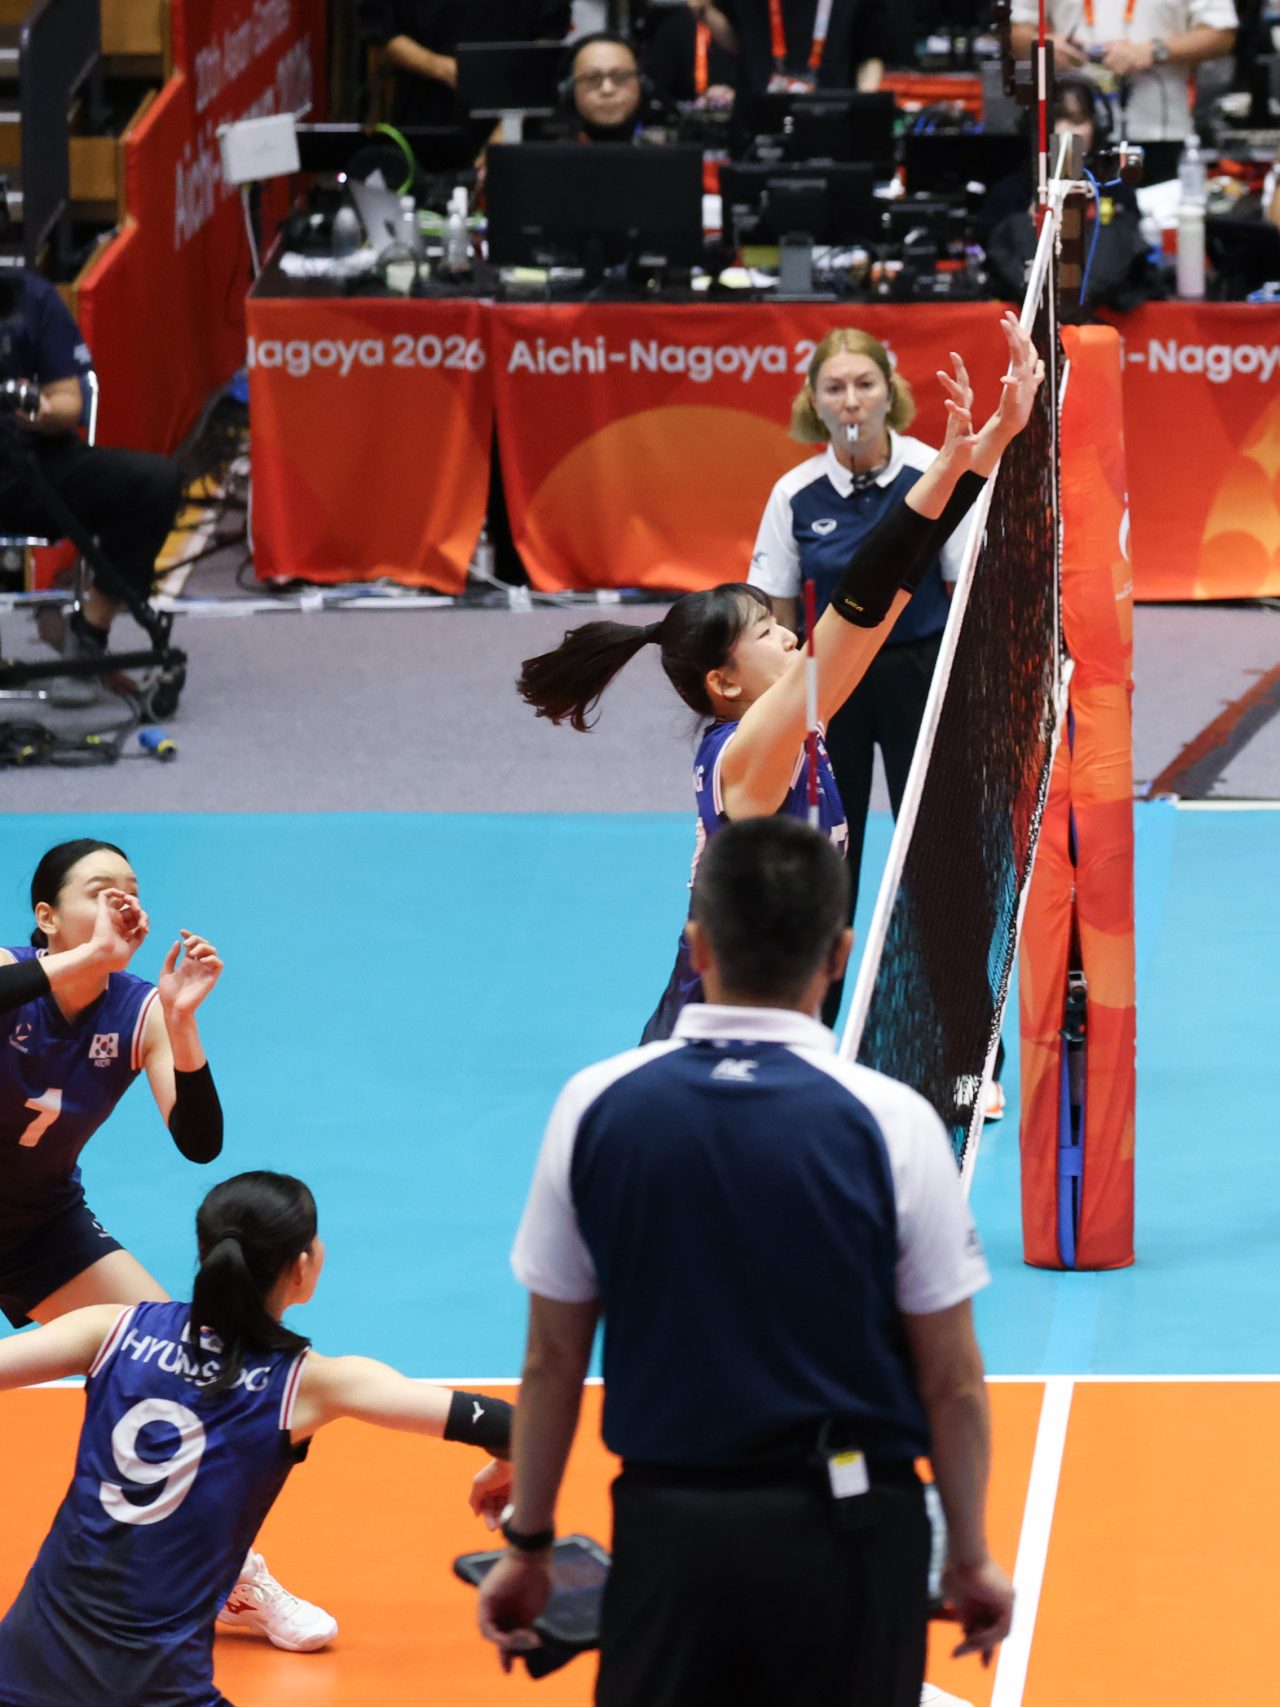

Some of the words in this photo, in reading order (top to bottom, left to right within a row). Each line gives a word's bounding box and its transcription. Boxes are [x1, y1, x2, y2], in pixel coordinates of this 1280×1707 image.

[392, 334, 487, 373] 2026
[507, 337, 788, 383] Aichi-Nagoya
[18, 1087, 63, 1147] 7
[99, 1398, 207, 1525] 9
